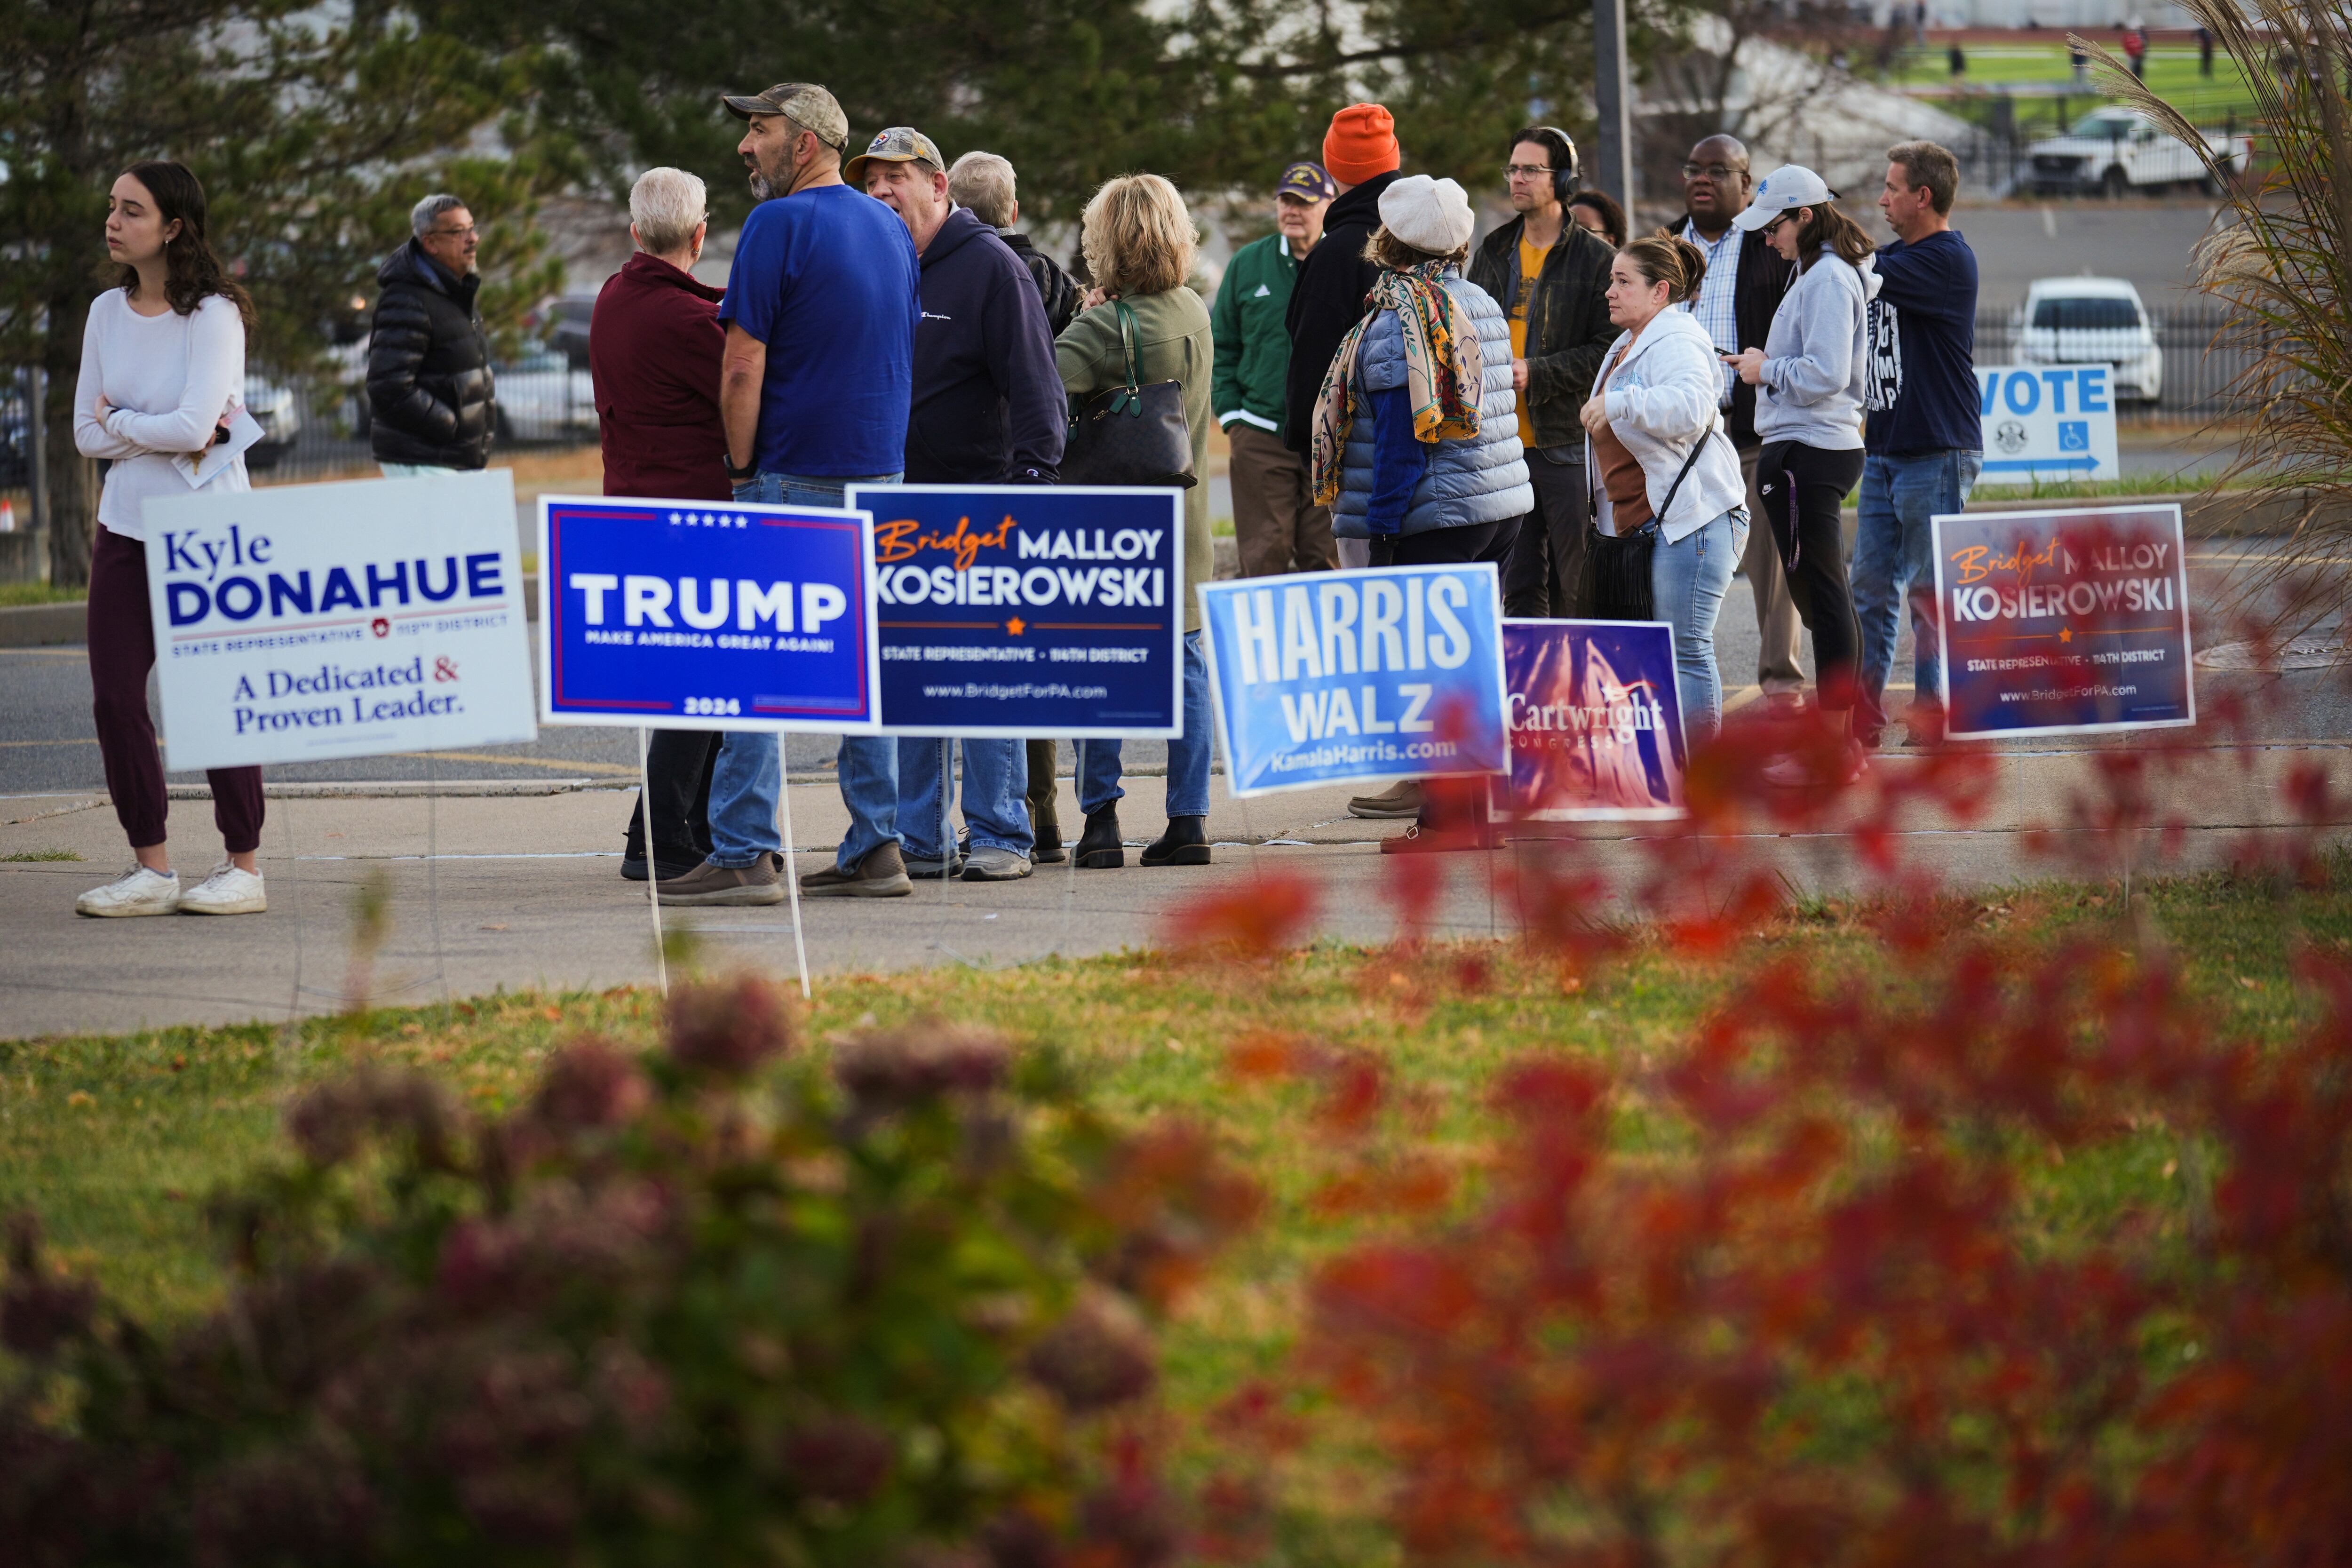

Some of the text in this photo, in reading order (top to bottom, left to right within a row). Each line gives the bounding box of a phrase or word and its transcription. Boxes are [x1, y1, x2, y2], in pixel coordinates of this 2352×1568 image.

[921, 311, 951, 320] Champion
[1976, 369, 2108, 416] VOTE
[162, 524, 273, 581] Kyle
[874, 514, 1164, 571] Bridget MALLOY
[1950, 537, 2060, 589] Bridget
[166, 552, 504, 628] DONAHUE
[569, 573, 847, 634] TRUMP
[876, 566, 1165, 607] KOSIEROWSKI
[1952, 577, 2173, 621] KOSIEROWSKI
[171, 640, 219, 658] STATE
[225, 627, 364, 652] REPRESENTATIVE
[435, 613, 508, 633] DISTRICT
[585, 630, 834, 653] MAKE AMERICA GREAT AGAIN!
[1232, 574, 1471, 685] HARRIS
[881, 646, 922, 661] STATE
[923, 646, 1035, 662] REPRESENTATIVE
[1088, 647, 1149, 663] DISTRICT
[1967, 659, 1997, 672] STATE
[2122, 649, 2166, 663] DISTRICT
[233, 656, 460, 702] A Dedicated &
[922, 682, 1107, 700] www.BridgetForPA.com
[233, 688, 465, 735] Proven Leader.
[684, 697, 740, 716] 2024
[1279, 683, 1434, 744] WALZ
[1506, 691, 1665, 744] Cartwright
[1271, 739, 1457, 773] KamalaHarris.com
